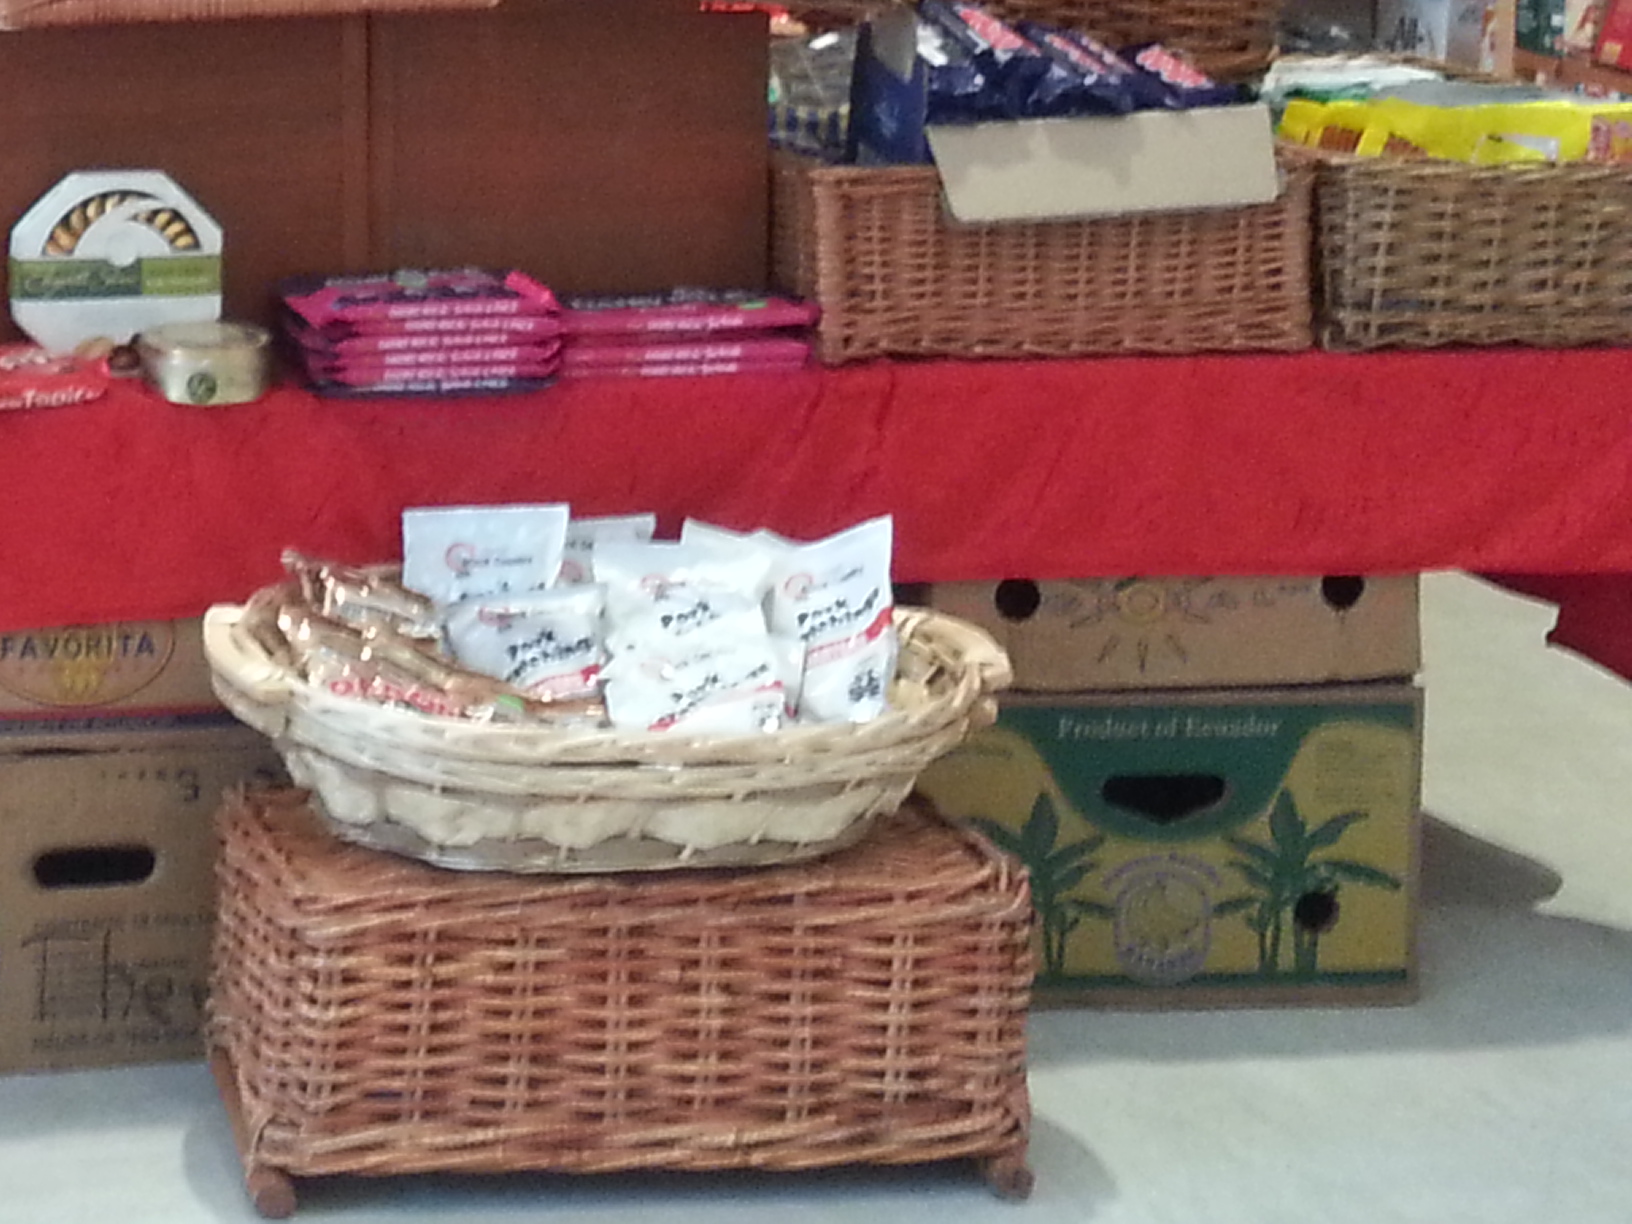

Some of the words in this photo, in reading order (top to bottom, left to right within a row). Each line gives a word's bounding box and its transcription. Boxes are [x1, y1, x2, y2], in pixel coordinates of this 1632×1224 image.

[0, 630, 156, 662] FAVORITA
[1057, 714, 1149, 740] Product
[1154, 714, 1179, 738] of
[1186, 714, 1279, 739] Ecuador
